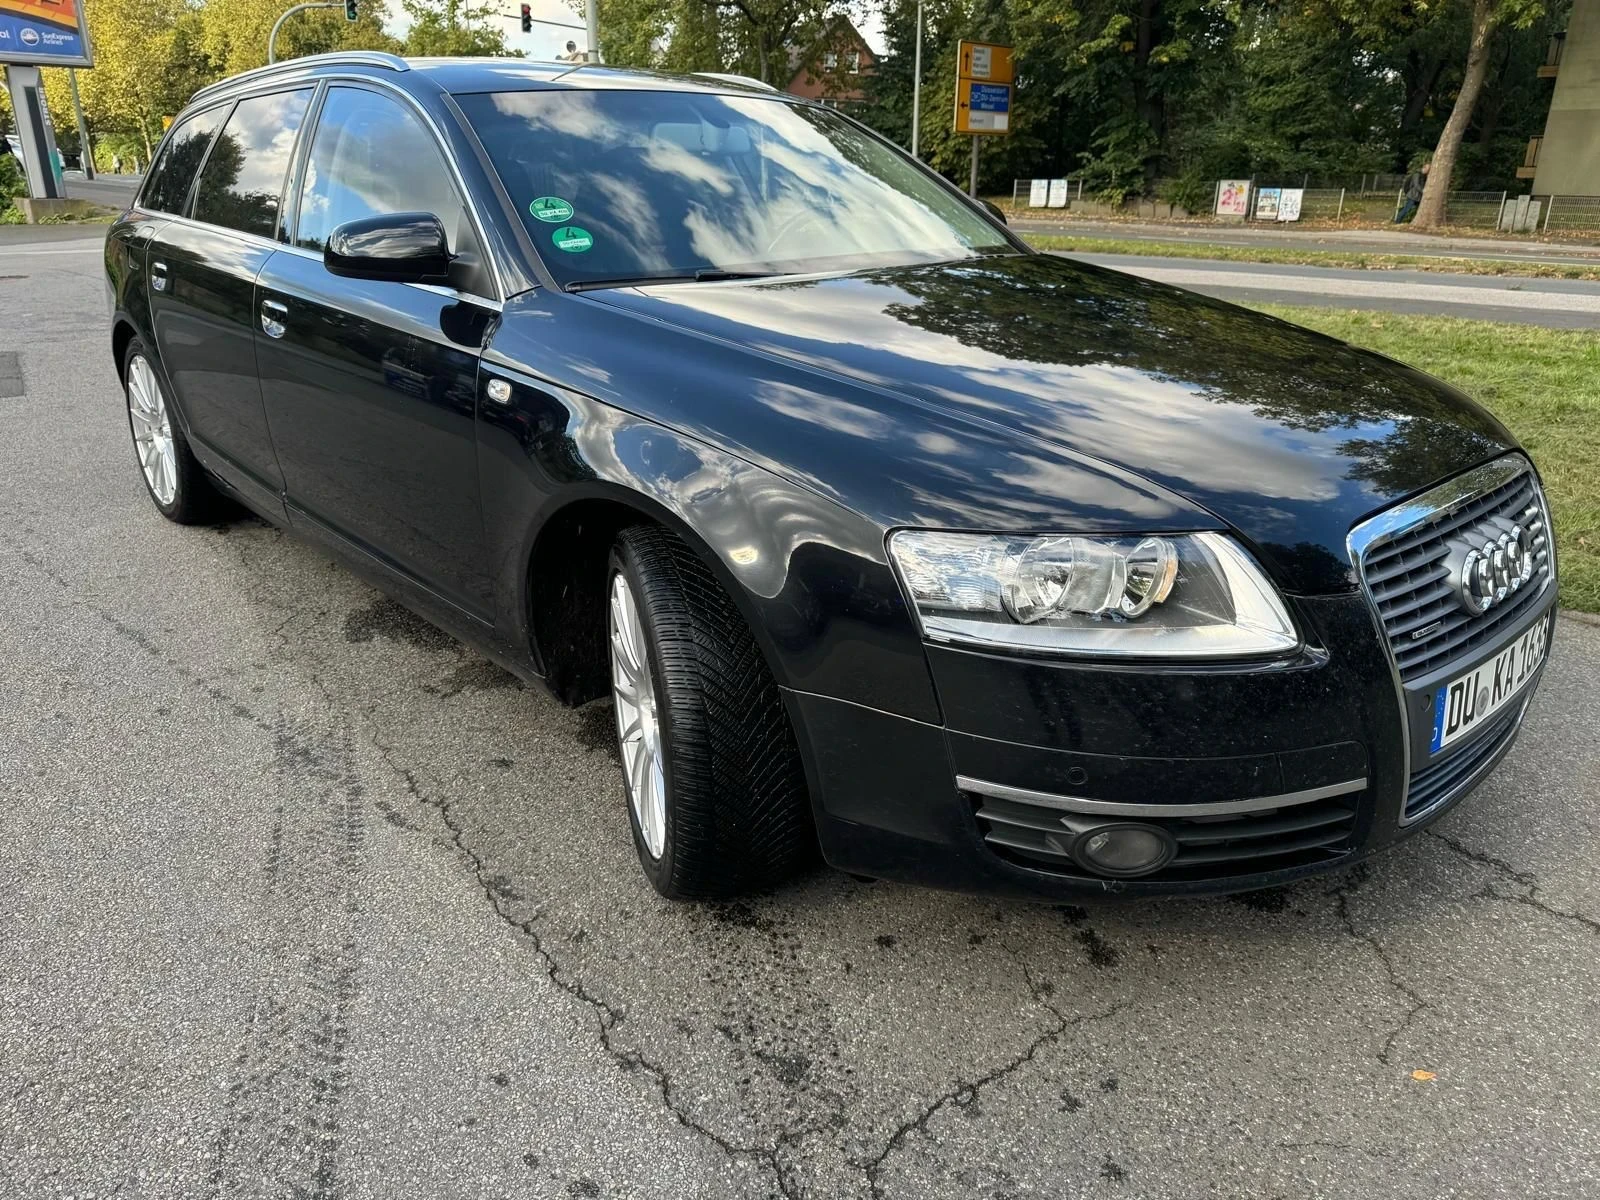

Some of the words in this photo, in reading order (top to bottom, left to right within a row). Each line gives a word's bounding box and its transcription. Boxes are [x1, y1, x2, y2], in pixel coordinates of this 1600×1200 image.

[41, 32, 74, 41] SunExpress
[544, 198, 557, 209] 4
[565, 228, 577, 239] 4
[1446, 672, 1480, 737] DU
[1491, 646, 1516, 706] KA
